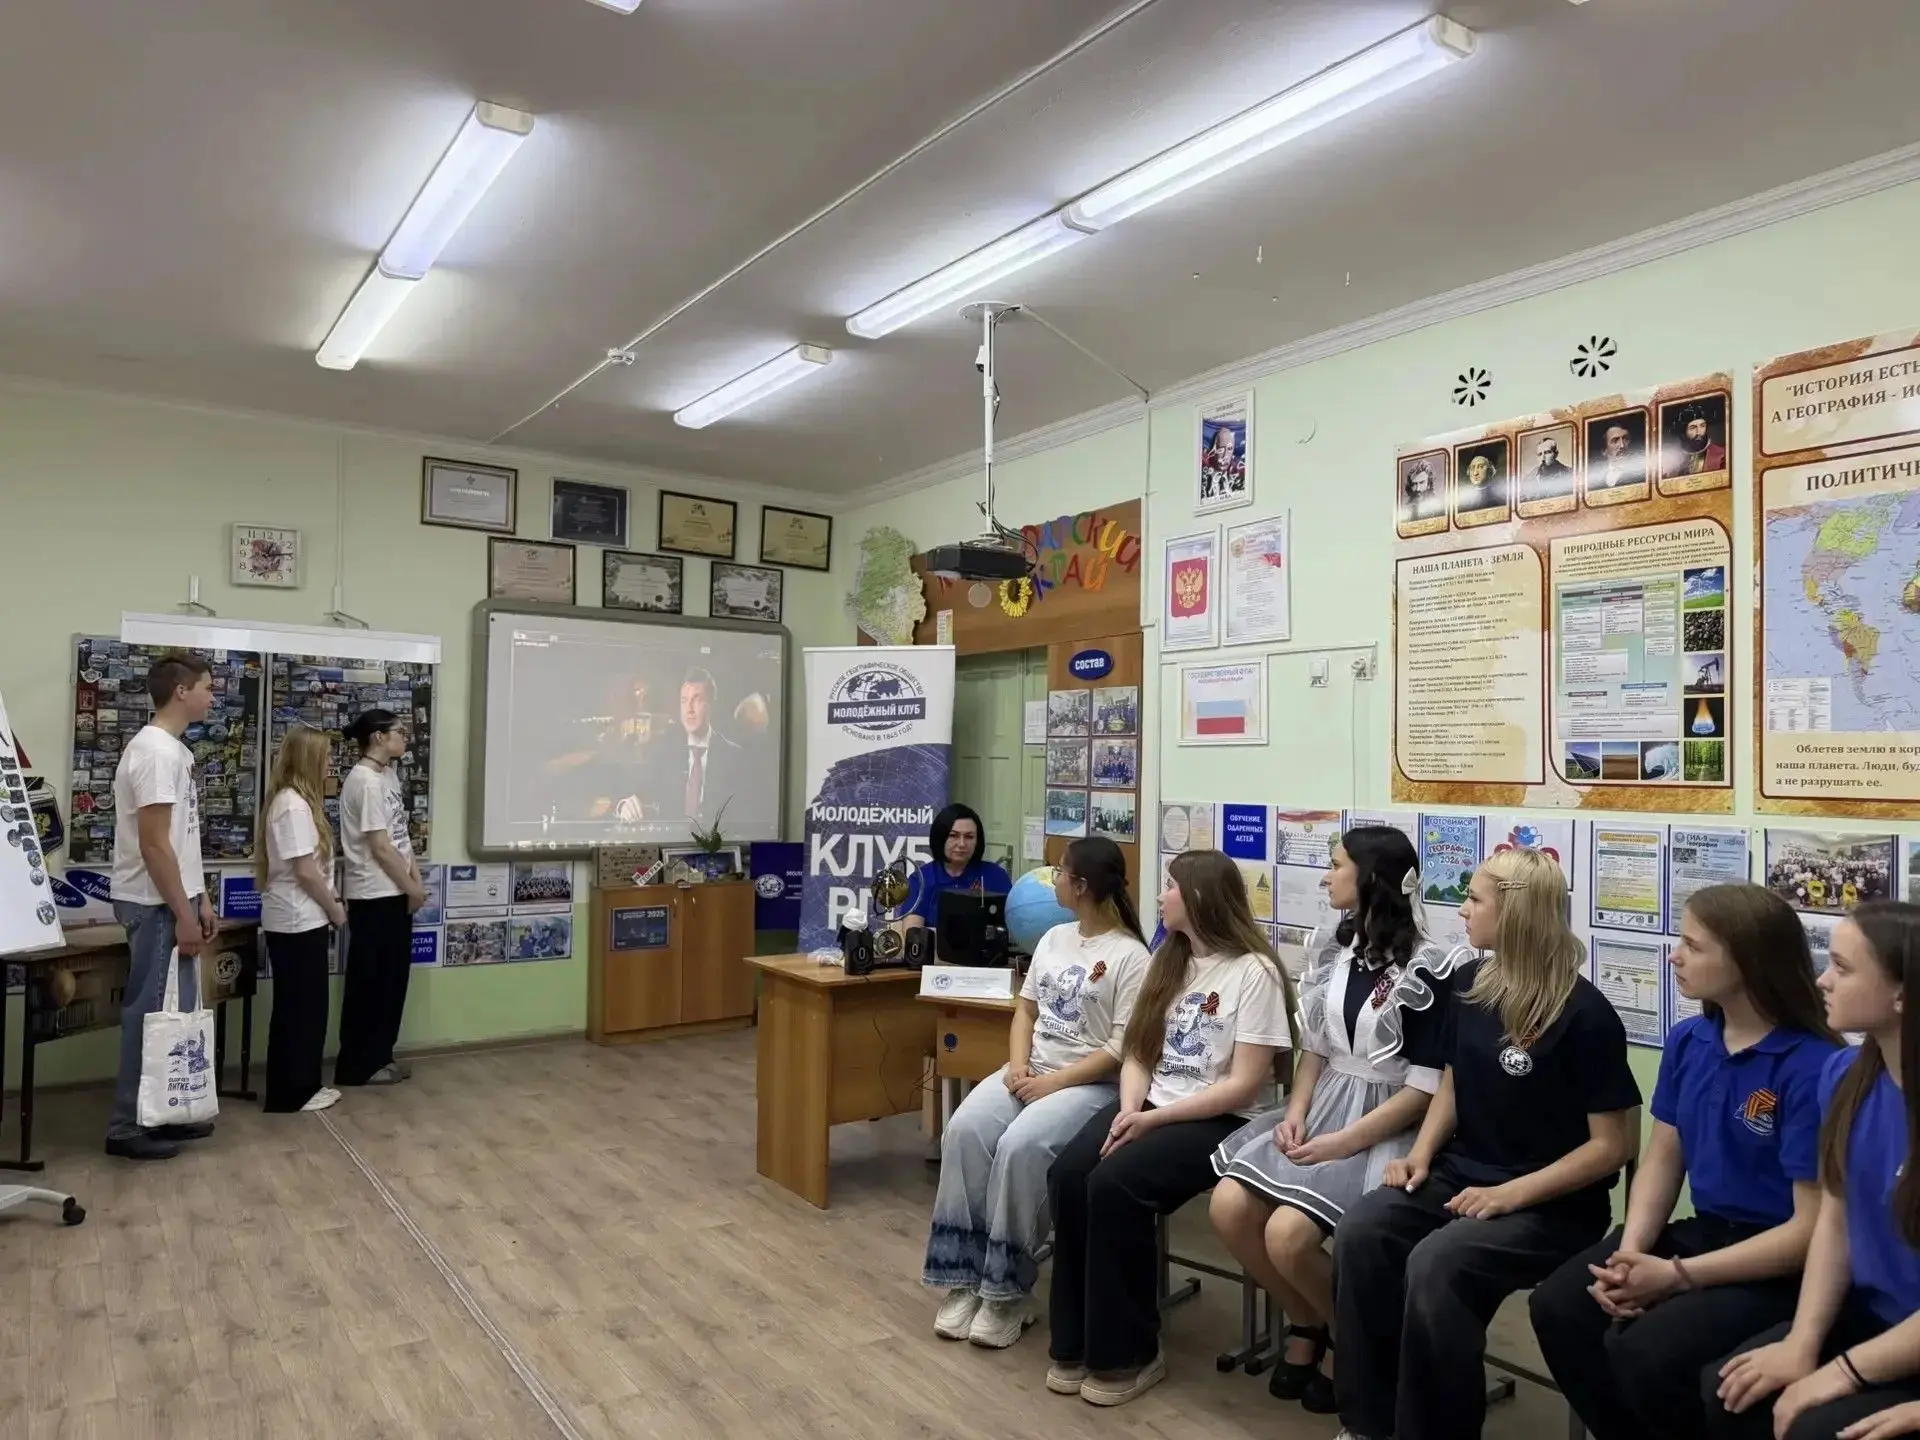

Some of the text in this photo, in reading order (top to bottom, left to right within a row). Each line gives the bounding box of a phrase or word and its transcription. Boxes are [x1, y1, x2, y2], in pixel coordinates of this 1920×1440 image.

[1771, 411, 1782, 424] А
[1787, 390, 1886, 421] ГЕОГРАФИЯ
[1564, 527, 1715, 555] ПРИРОДНЫЕ РЕССУРСЫ МИРА
[1412, 563, 1439, 575] НАША
[1441, 557, 1484, 571] ПЛАНЕТА
[1491, 551, 1524, 565] ЗЕМЛЯ
[833, 703, 921, 719] МОЛОДЁЖНЫЙ КЛУБ
[1796, 744, 1844, 754] Облетев
[1846, 746, 1886, 754] землю
[1776, 762, 1805, 770] наша
[1808, 763, 1860, 771] планета.
[1862, 761, 1899, 772] Люди,
[1800, 778, 1864, 788] разрушать
[1866, 779, 1883, 787] ее.
[811, 802, 934, 825] МОЛОДЁЖНЫЙ
[1429, 818, 1473, 826] ГОТОВИМСЯ
[1227, 824, 1264, 833] ОДАРЕННЫХ
[1235, 834, 1254, 843] ДЕТЕЙ
[1686, 833, 1708, 842] ГИА-9
[1429, 844, 1473, 855] ГЕОГРАФИЯ
[1440, 856, 1460, 865] 2026
